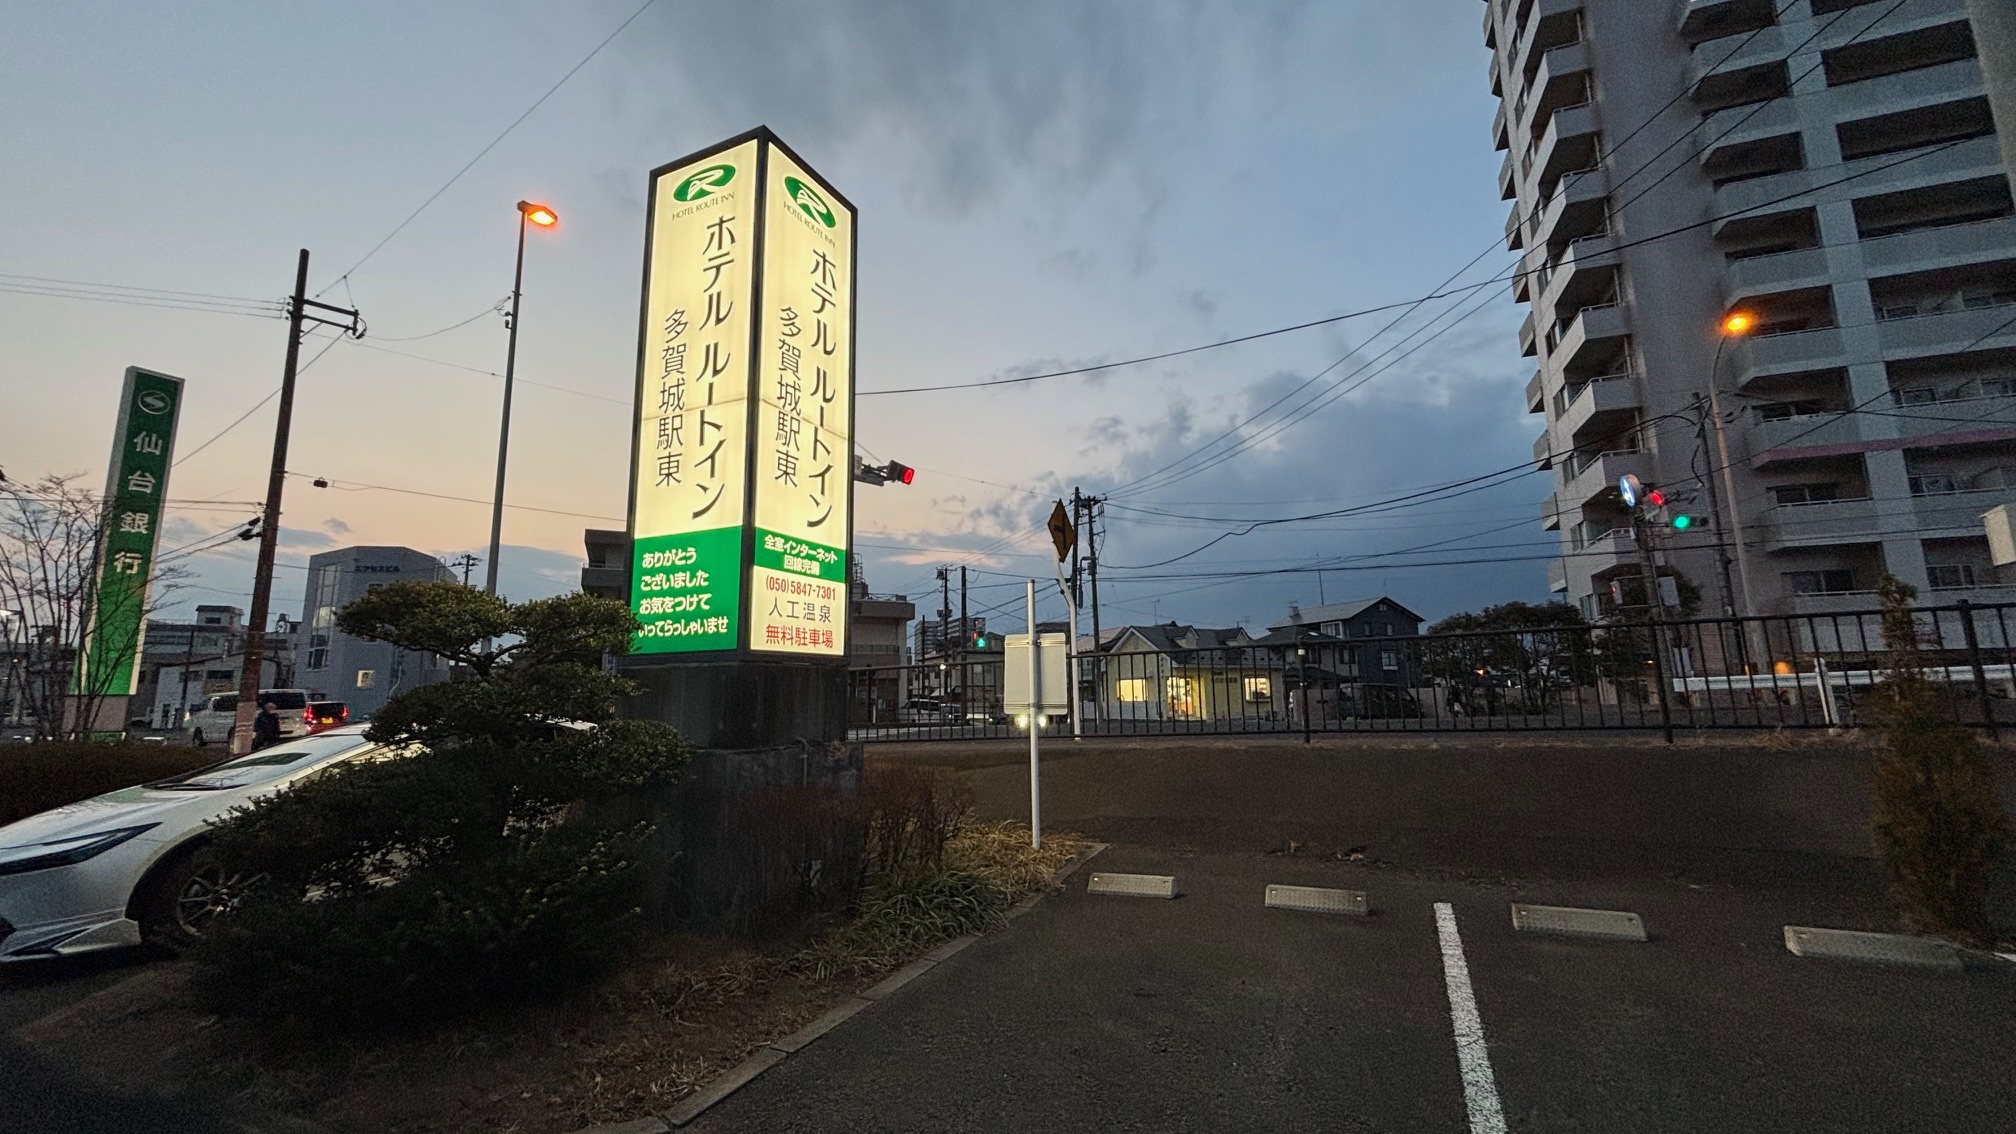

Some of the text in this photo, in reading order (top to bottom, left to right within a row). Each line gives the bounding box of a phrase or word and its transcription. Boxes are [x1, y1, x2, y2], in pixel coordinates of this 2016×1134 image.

[672, 191, 735, 221] HOTEL ROUTE INN
[783, 201, 836, 248] HOTEL ROUTE INN
[692, 215, 736, 519] ホテルルートイン
[655, 308, 690, 487] 多賀城駅東
[775, 306, 802, 488] 多賀城駅東
[806, 248, 836, 528] ホテルルートイン
[113, 431, 163, 574] 仙台銀行
[642, 547, 697, 568] ありがとう
[764, 534, 838, 564] 全室インターネット
[783, 554, 820, 576] 回線完備
[640, 569, 709, 591] ございました
[765, 575, 836, 601] (050)5847-7301
[639, 593, 712, 614] お気をつけて
[768, 597, 831, 623] 人工温泉
[638, 616, 728, 637] いってらっしゃいませ
[765, 624, 834, 648] 無料駐車場
